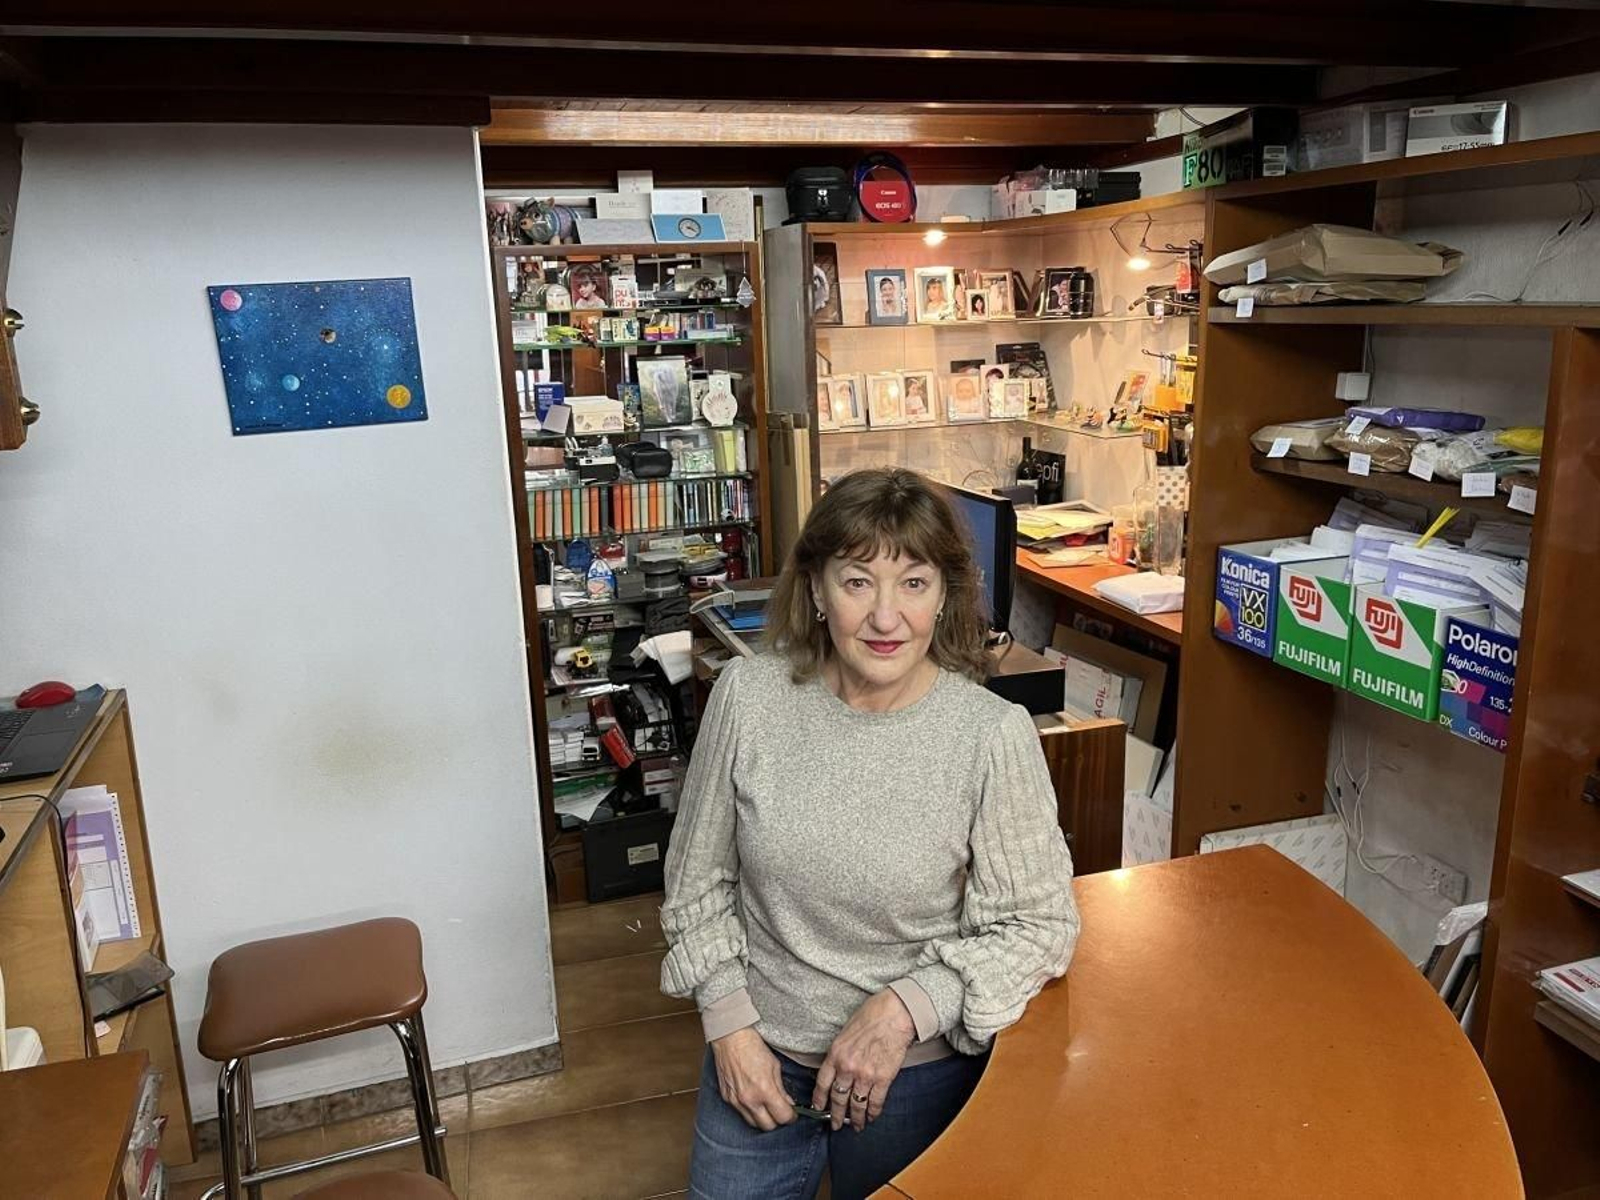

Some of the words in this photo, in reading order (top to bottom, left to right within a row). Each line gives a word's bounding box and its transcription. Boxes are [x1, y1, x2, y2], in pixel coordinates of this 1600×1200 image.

[1184, 147, 1224, 188] F80
[1221, 556, 1270, 589] Konica
[1242, 587, 1266, 613] VX
[1290, 580, 1320, 616] FUJI
[1241, 605, 1265, 629] 100
[1367, 601, 1401, 642] FUJI
[1278, 640, 1341, 677] FUJIFILM
[1094, 686, 1107, 719] AGIL
[1352, 667, 1425, 709] FUJIFILM
[1440, 714, 1453, 728] DX
[1468, 726, 1498, 748] Colour
[1500, 739, 1508, 750] P
